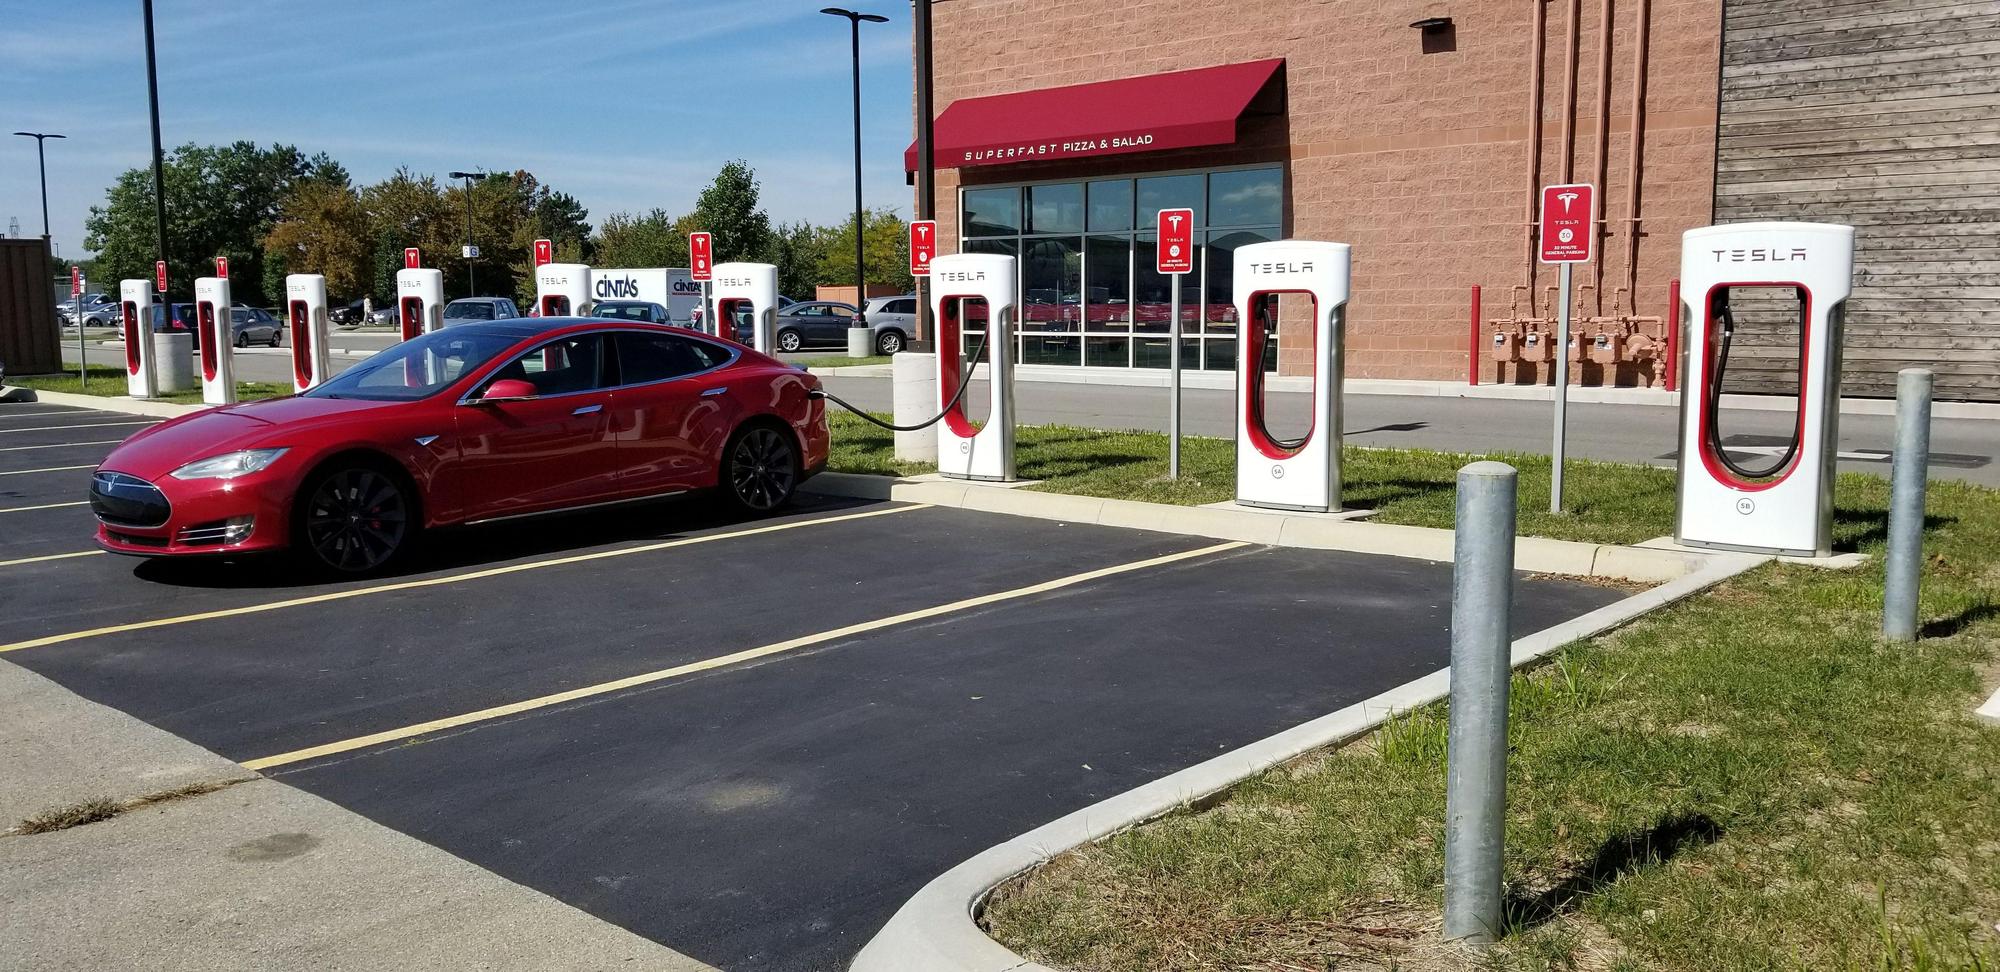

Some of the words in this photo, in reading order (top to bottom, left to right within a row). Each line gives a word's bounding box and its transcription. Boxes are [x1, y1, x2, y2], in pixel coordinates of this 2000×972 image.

[964, 144, 1058, 161] SUPERFAST
[1063, 140, 1096, 152] PIZZA
[1100, 139, 1108, 149] &
[1112, 134, 1153, 148] SALAD
[470, 247, 478, 256] G
[1712, 248, 1807, 262] TESLA
[1250, 262, 1313, 274] TESLA
[541, 277, 568, 285] TESLA
[940, 271, 985, 281] TESLA
[718, 278, 751, 287] TESLA
